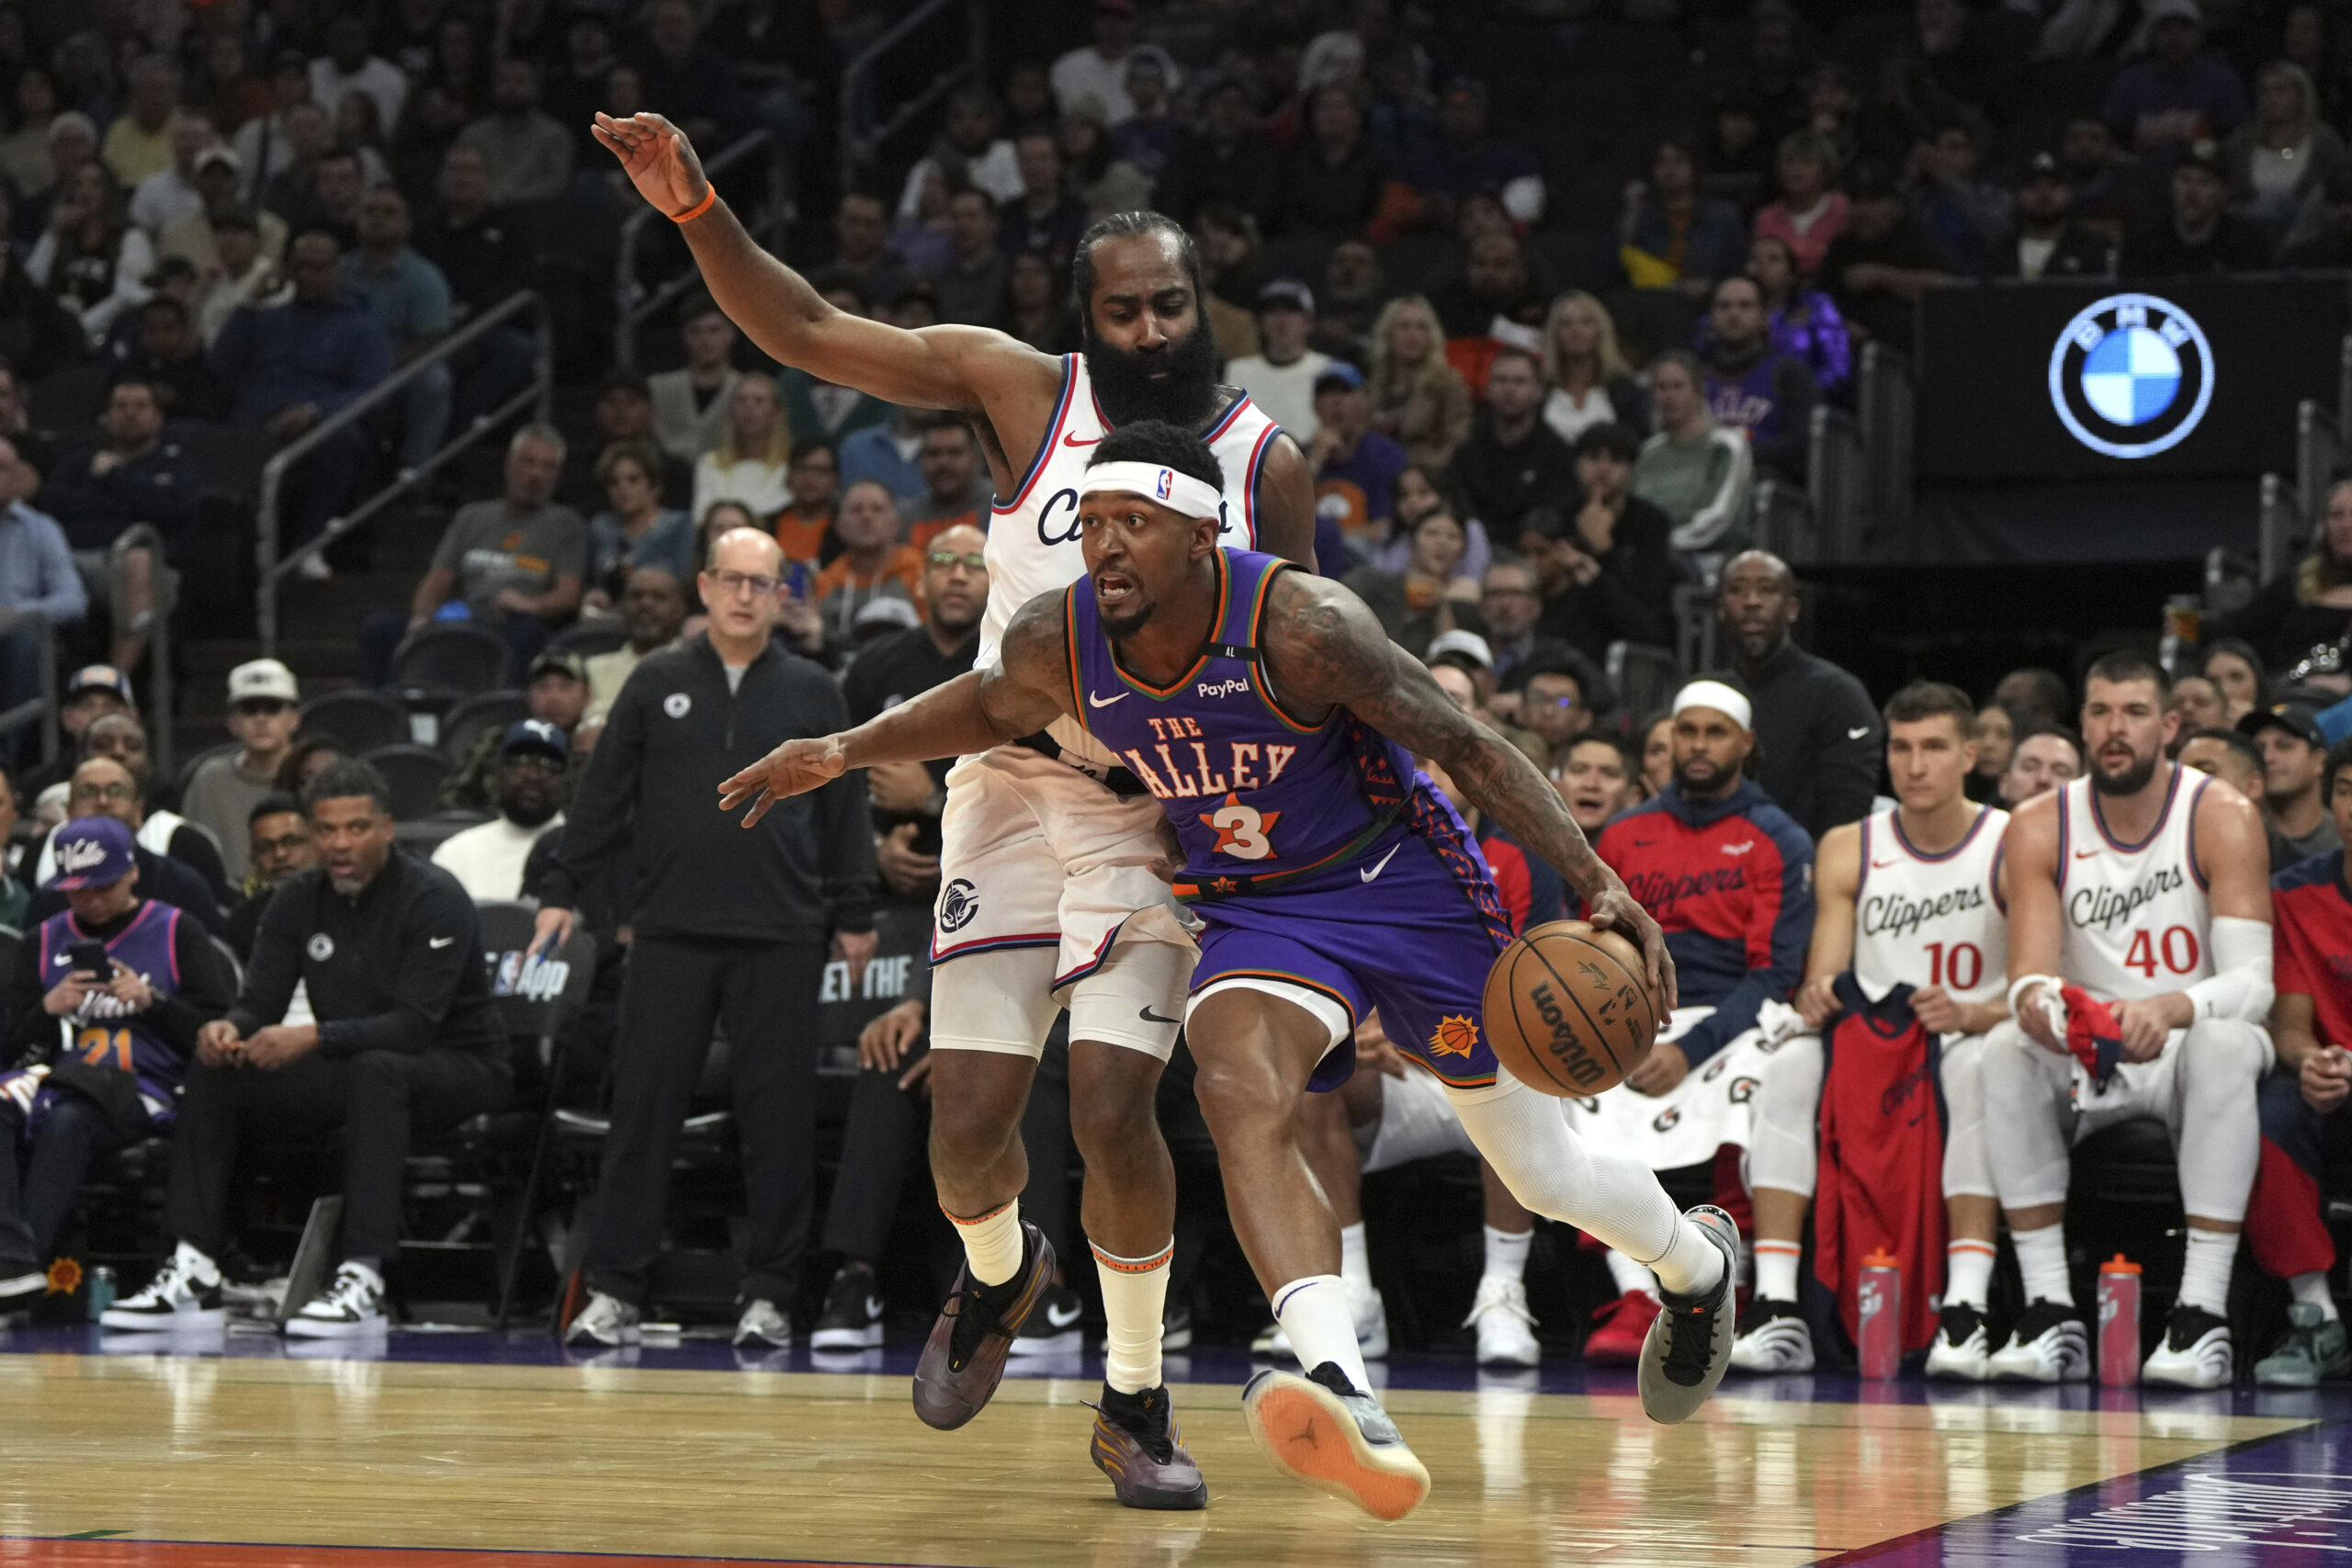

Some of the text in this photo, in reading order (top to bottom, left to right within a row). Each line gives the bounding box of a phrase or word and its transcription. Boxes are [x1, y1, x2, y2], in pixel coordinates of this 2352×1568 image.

[2074, 305, 2191, 352] BMW
[1226, 646, 1235, 658] AL
[1197, 678, 1250, 699] PayPal
[1148, 716, 1204, 741] THE
[1110, 741, 1297, 799] ALLEY
[1212, 805, 1271, 860] 3
[1628, 865, 1747, 915] Clippers
[1863, 885, 1984, 939] Clippers
[2070, 863, 2184, 931] Clippers
[1923, 941, 1983, 991] 10
[2124, 925, 2199, 978] 40
[514, 953, 571, 1002] App
[819, 960, 851, 1003] ET
[1530, 977, 1607, 1088] Wilson
